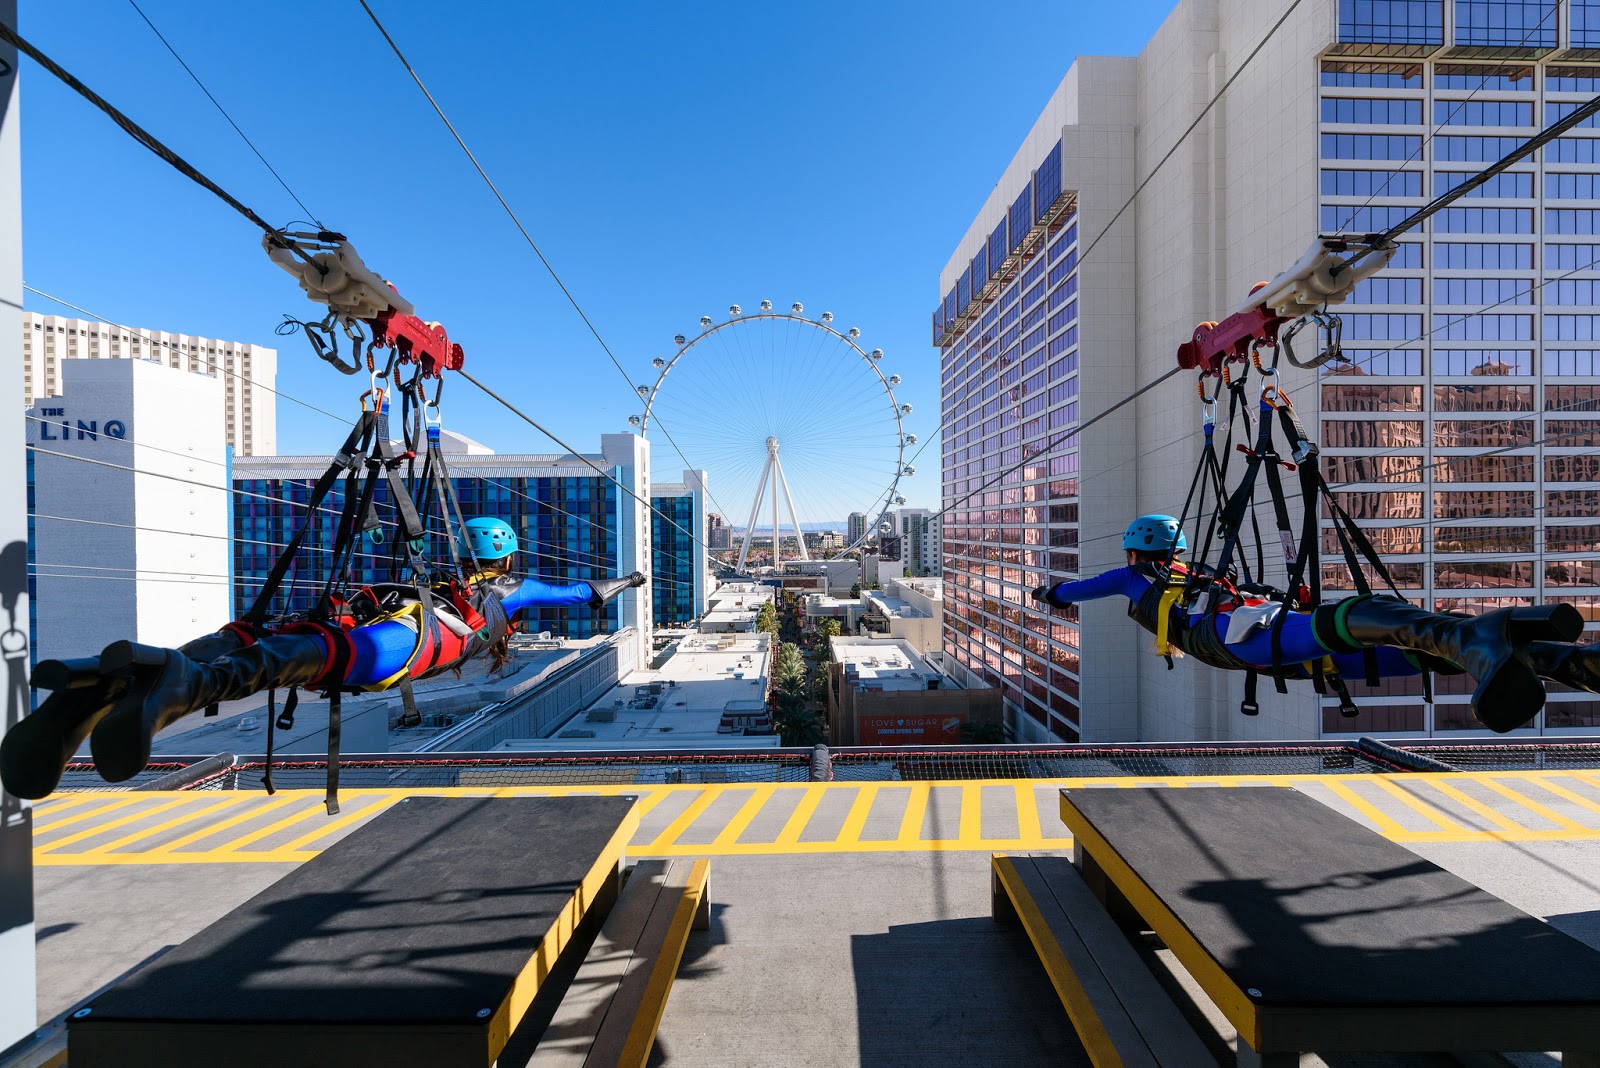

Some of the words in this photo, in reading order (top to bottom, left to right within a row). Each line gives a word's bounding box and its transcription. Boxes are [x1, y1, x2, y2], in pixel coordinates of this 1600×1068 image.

[41, 408, 64, 417] THE
[41, 420, 126, 441] LINQ
[906, 719, 938, 727] SUGAR
